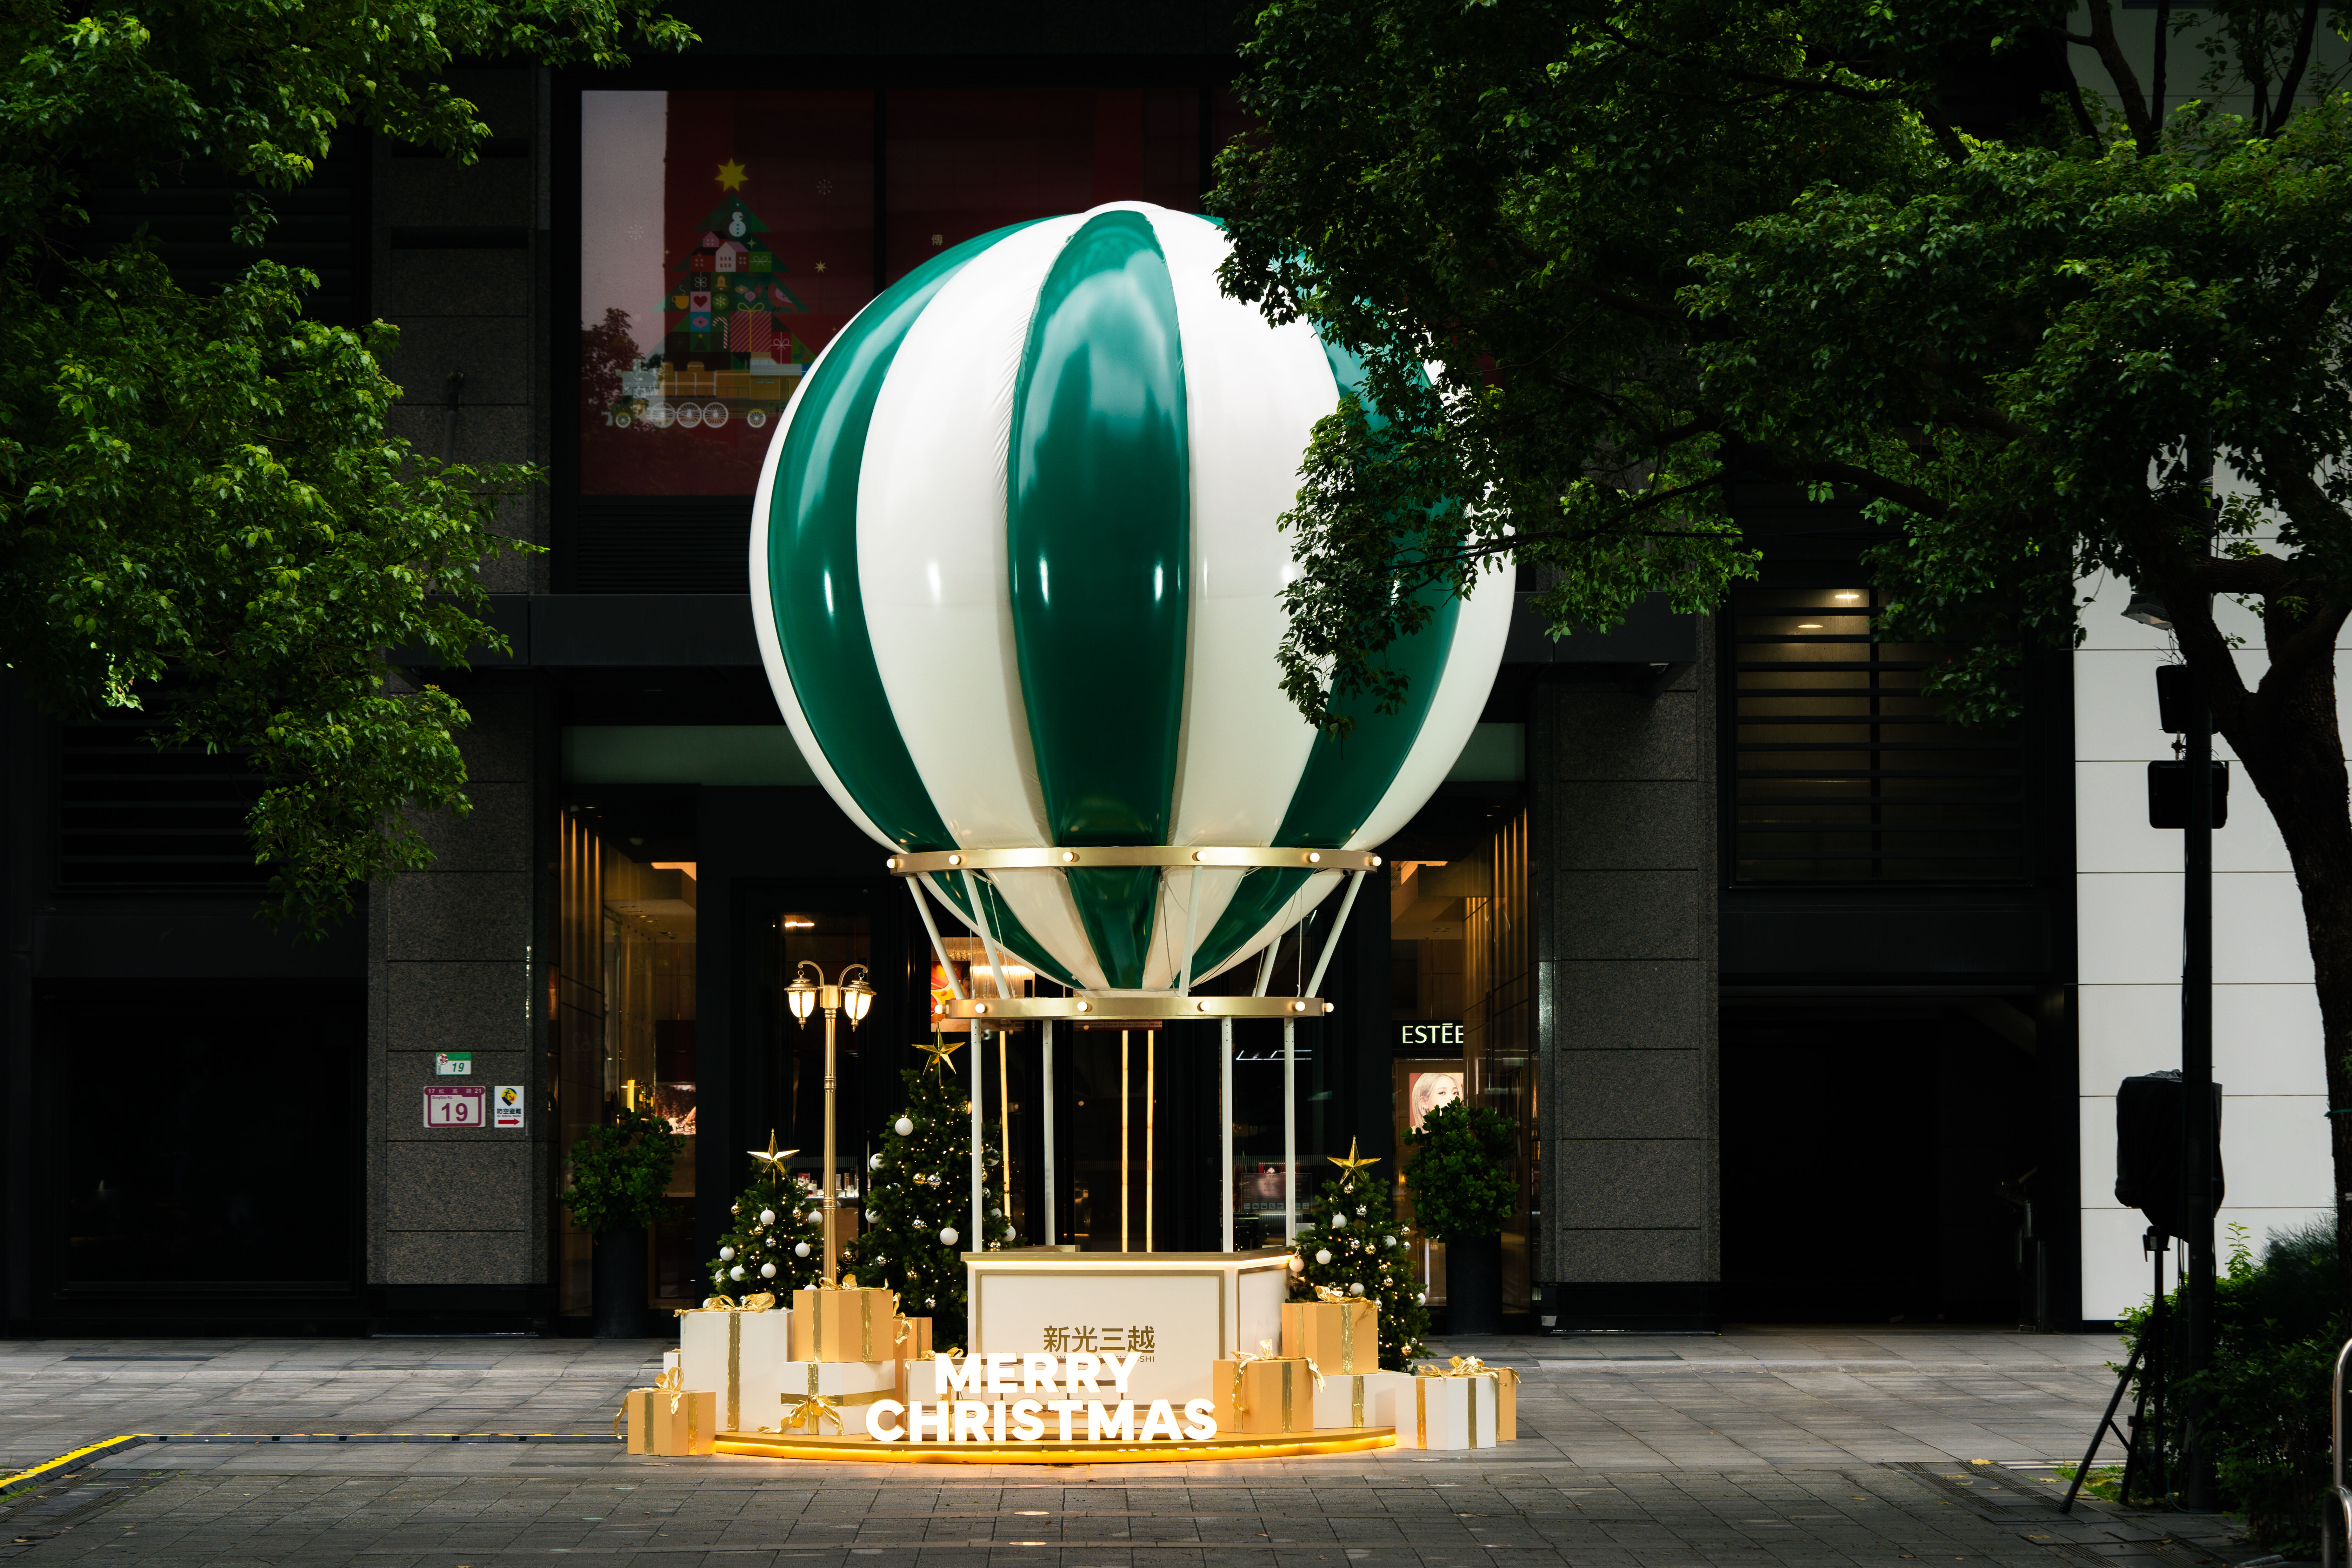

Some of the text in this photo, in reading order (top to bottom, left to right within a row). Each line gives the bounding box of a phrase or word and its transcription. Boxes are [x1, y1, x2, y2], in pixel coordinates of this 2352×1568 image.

[452, 1062, 464, 1072] 19
[441, 1102, 468, 1122] 19
[1043, 1325, 1155, 1353] 新光三越
[935, 1351, 1143, 1394] MERRY
[865, 1397, 1218, 1442] CHRISTMAS
